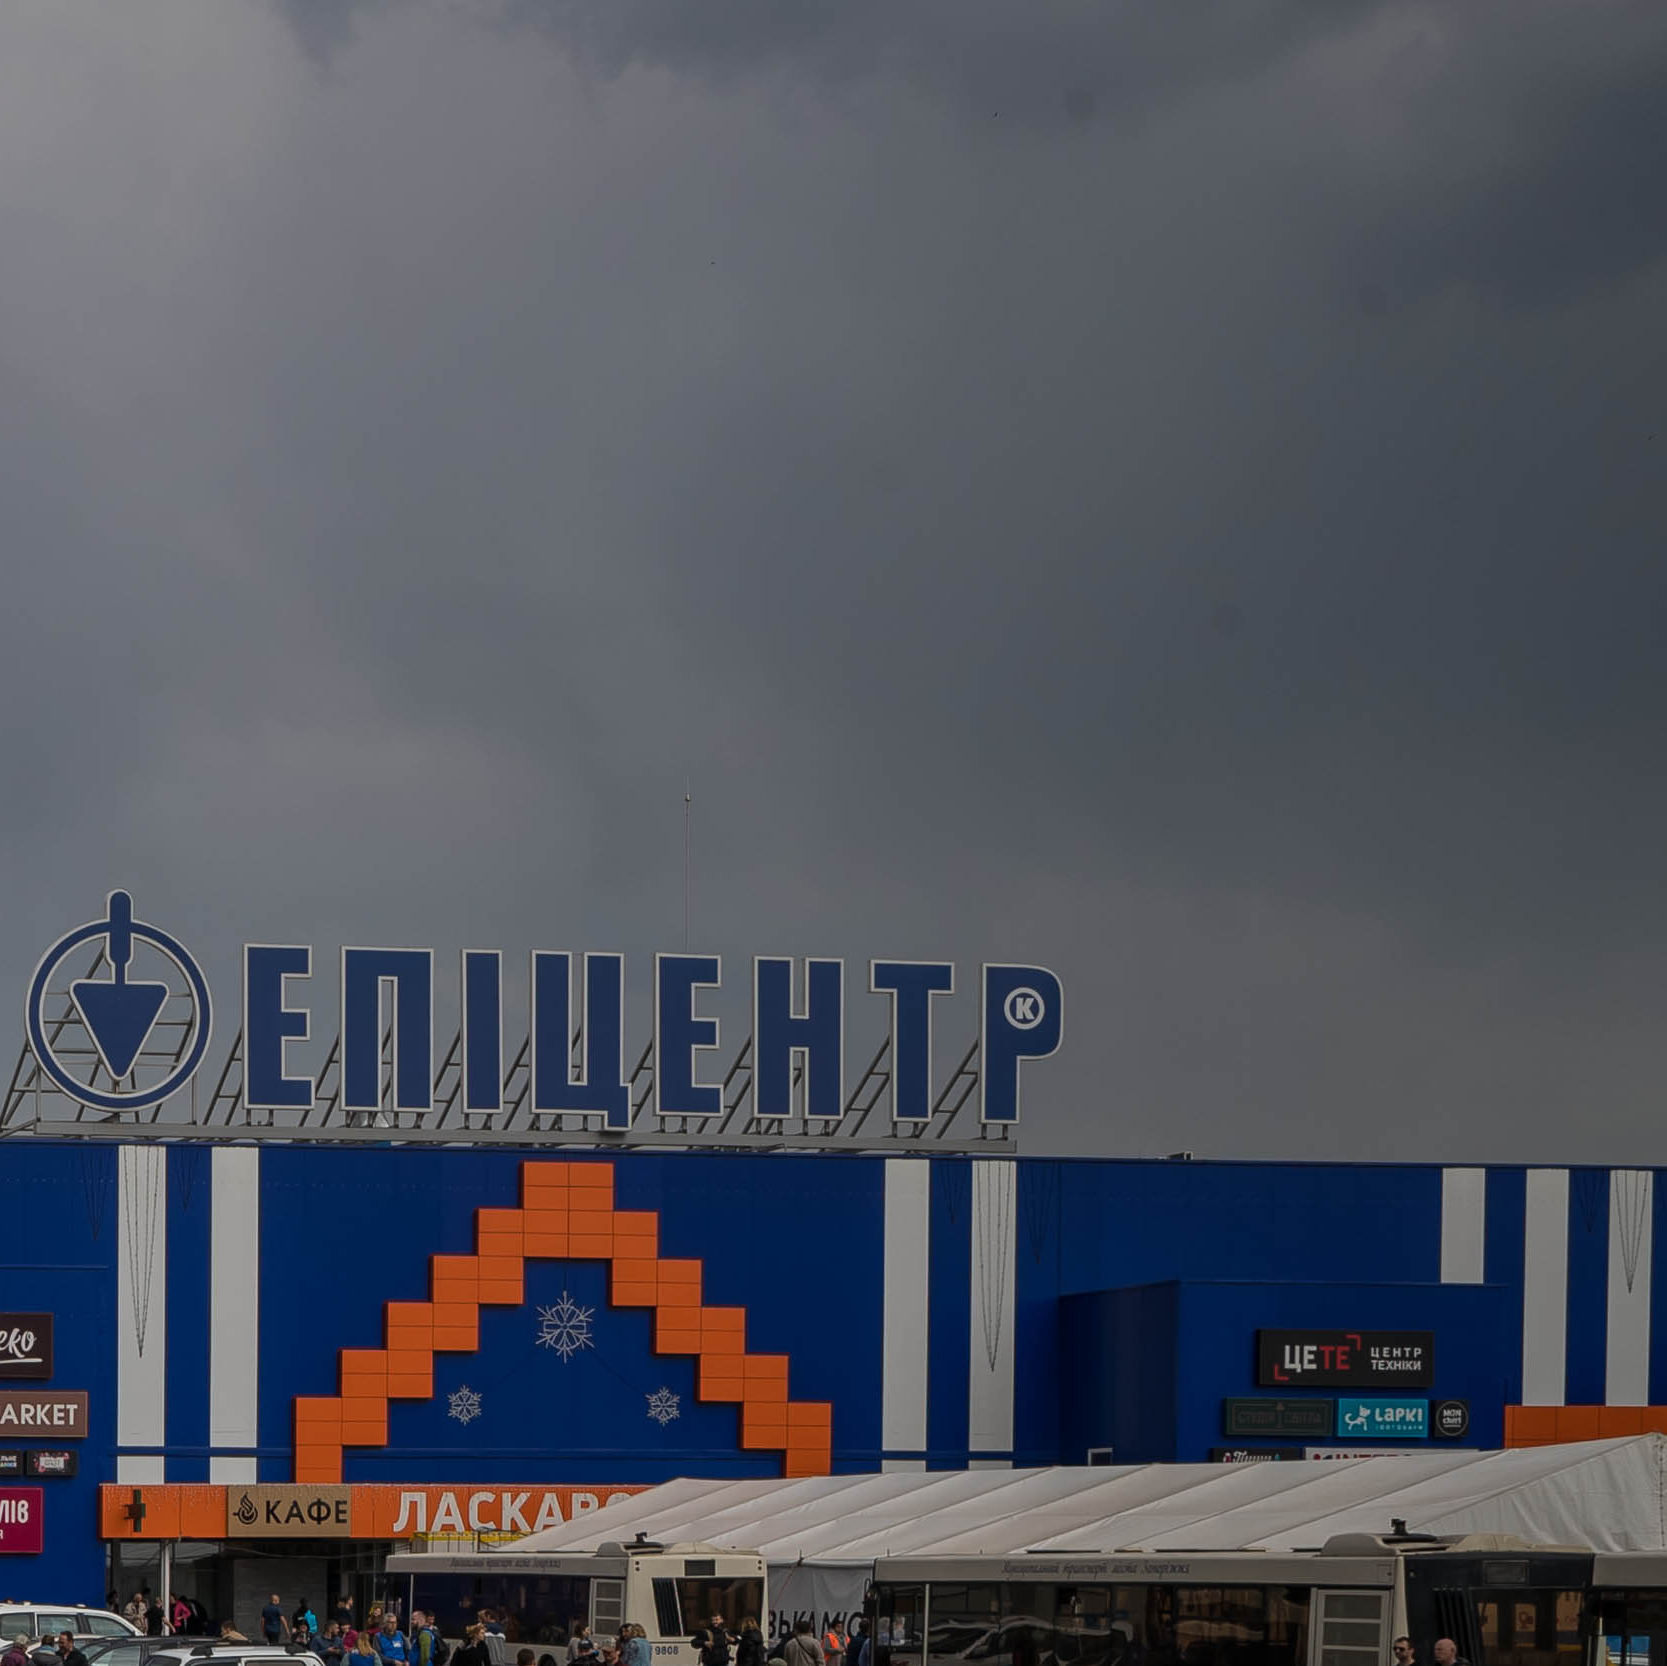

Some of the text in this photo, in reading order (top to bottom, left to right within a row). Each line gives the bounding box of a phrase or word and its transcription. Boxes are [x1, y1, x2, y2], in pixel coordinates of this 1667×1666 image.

[242, 942, 1065, 1131] ЕПІЦЕНТР
[1284, 1344, 1351, 1373] ЦЕТЕ
[1370, 1346, 1423, 1359] ЦЕНТР
[1370, 1360, 1422, 1371] ТЕХНІКИ
[265, 1498, 348, 1526] КАФЕ
[393, 1491, 633, 1534] ЛАСКАВ
